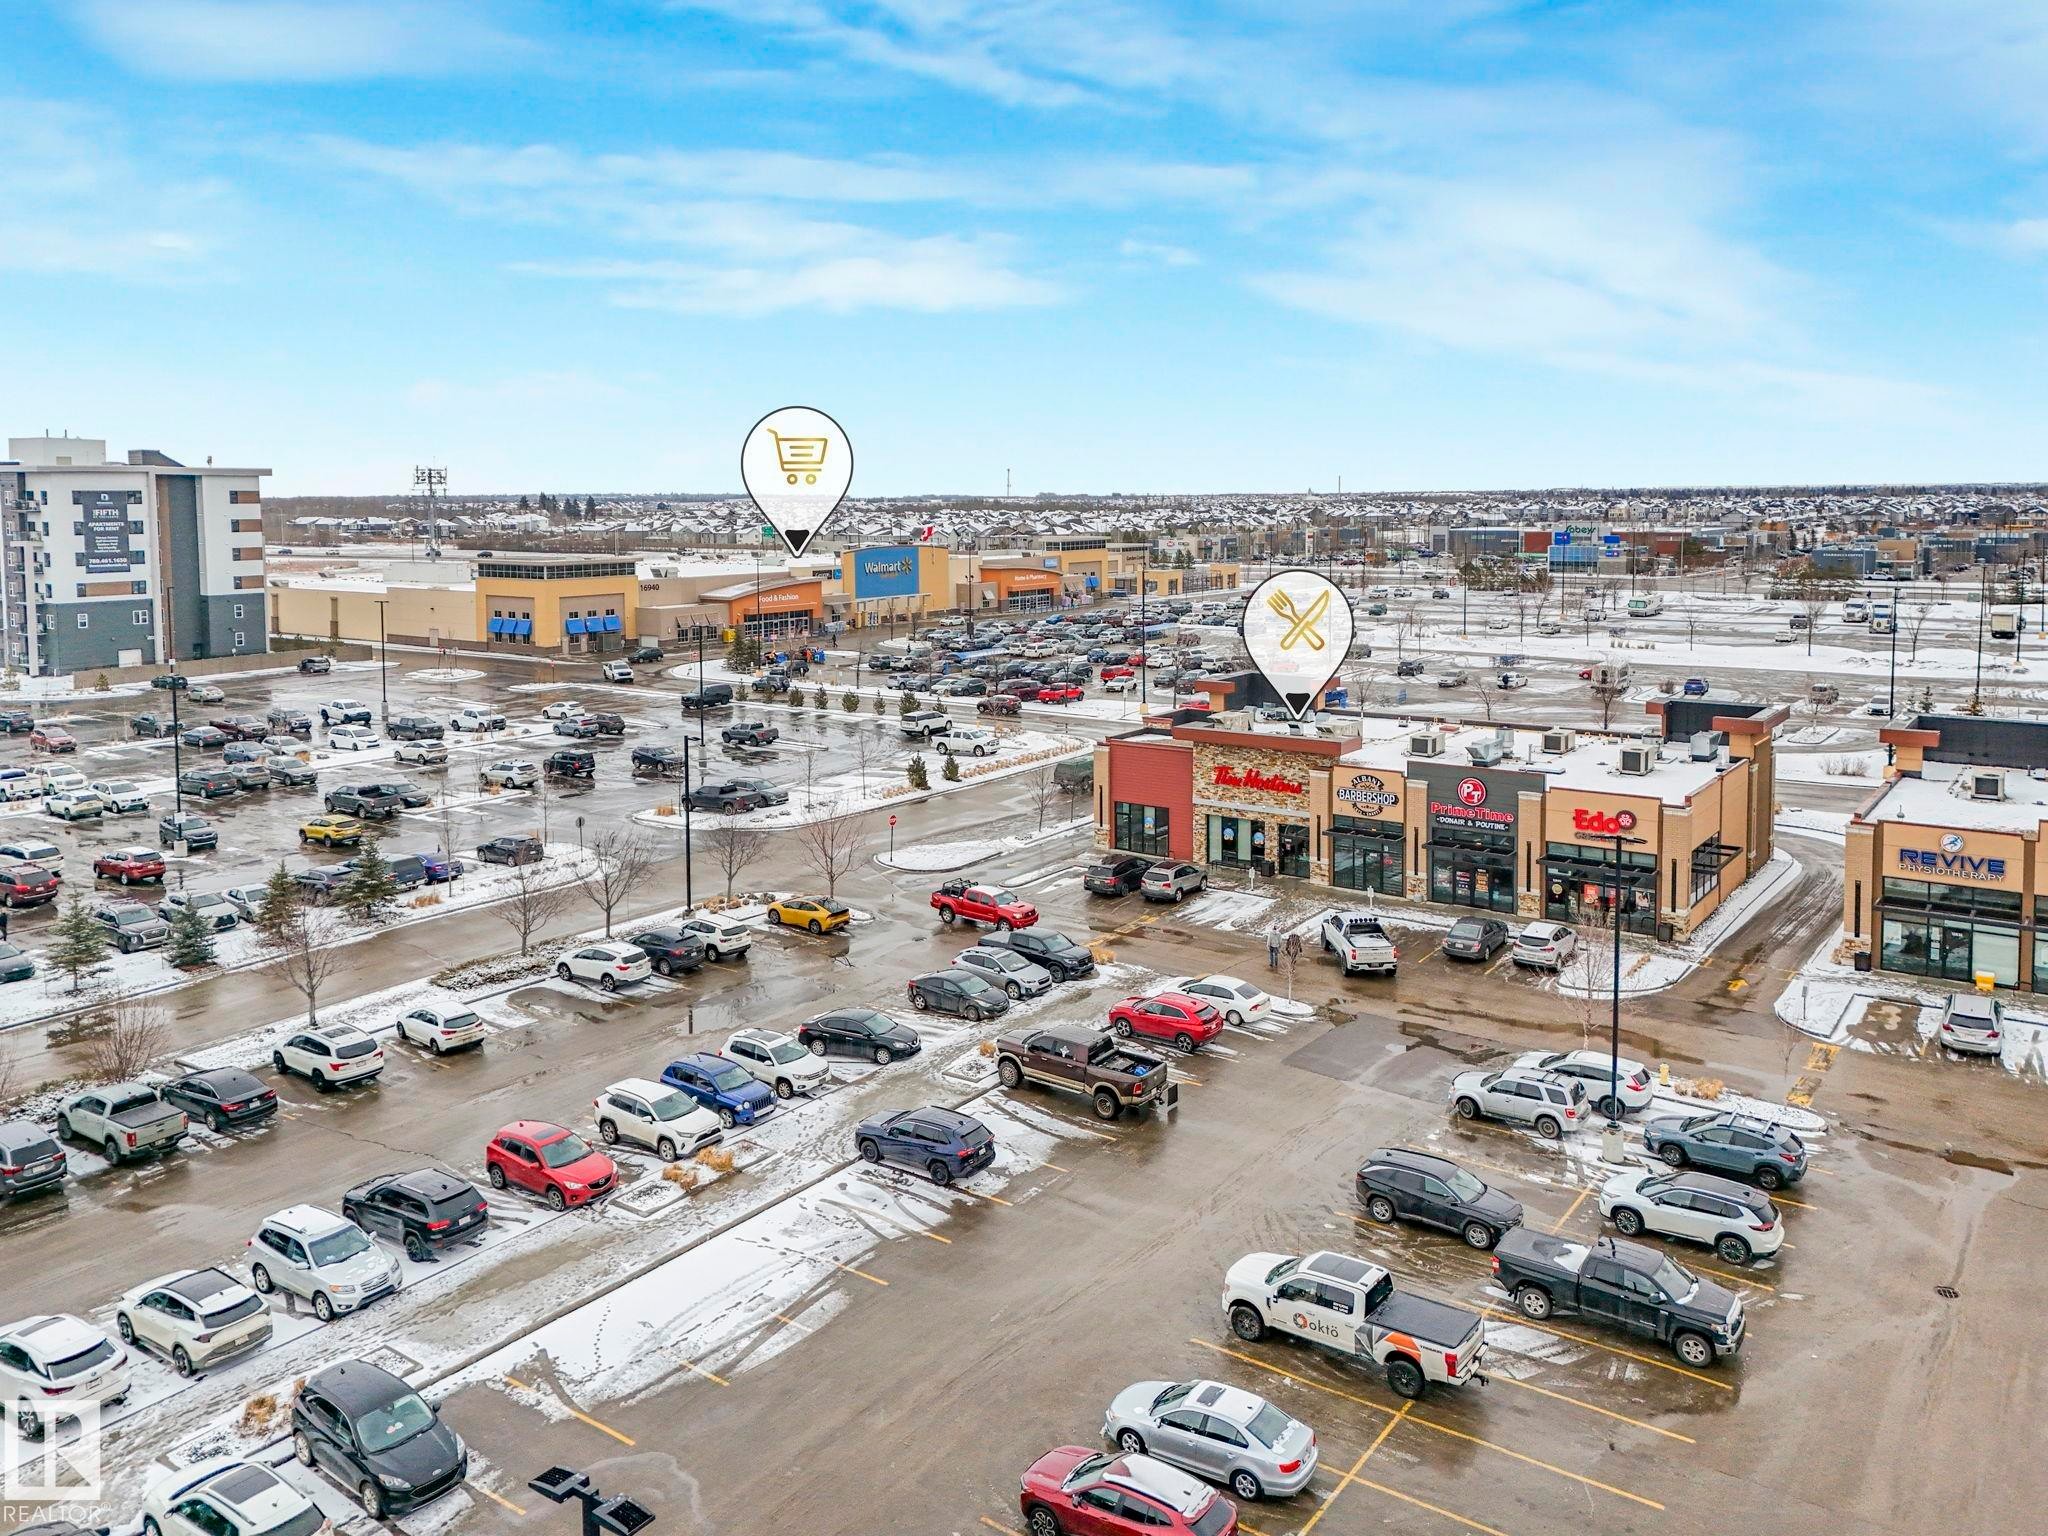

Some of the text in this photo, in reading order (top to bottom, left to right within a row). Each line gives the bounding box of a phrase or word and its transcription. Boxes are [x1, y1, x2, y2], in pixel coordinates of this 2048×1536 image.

[1565, 524, 1596, 535] Sobeys
[864, 560, 901, 574] Walmart
[640, 583, 660, 591] 16940
[759, 595, 773, 603] Food
[778, 593, 800, 601] Fashion
[1213, 765, 1302, 794] Tim Hortons
[1352, 775, 1382, 787] ALBANY
[1339, 789, 1396, 805] BARBERSHOP
[1574, 808, 1620, 834] Edo
[1899, 848, 2005, 874] REVIVE
[1898, 863, 2005, 882] PHYSIOTHERAPY
[1309, 1320, 1339, 1338] oktö
